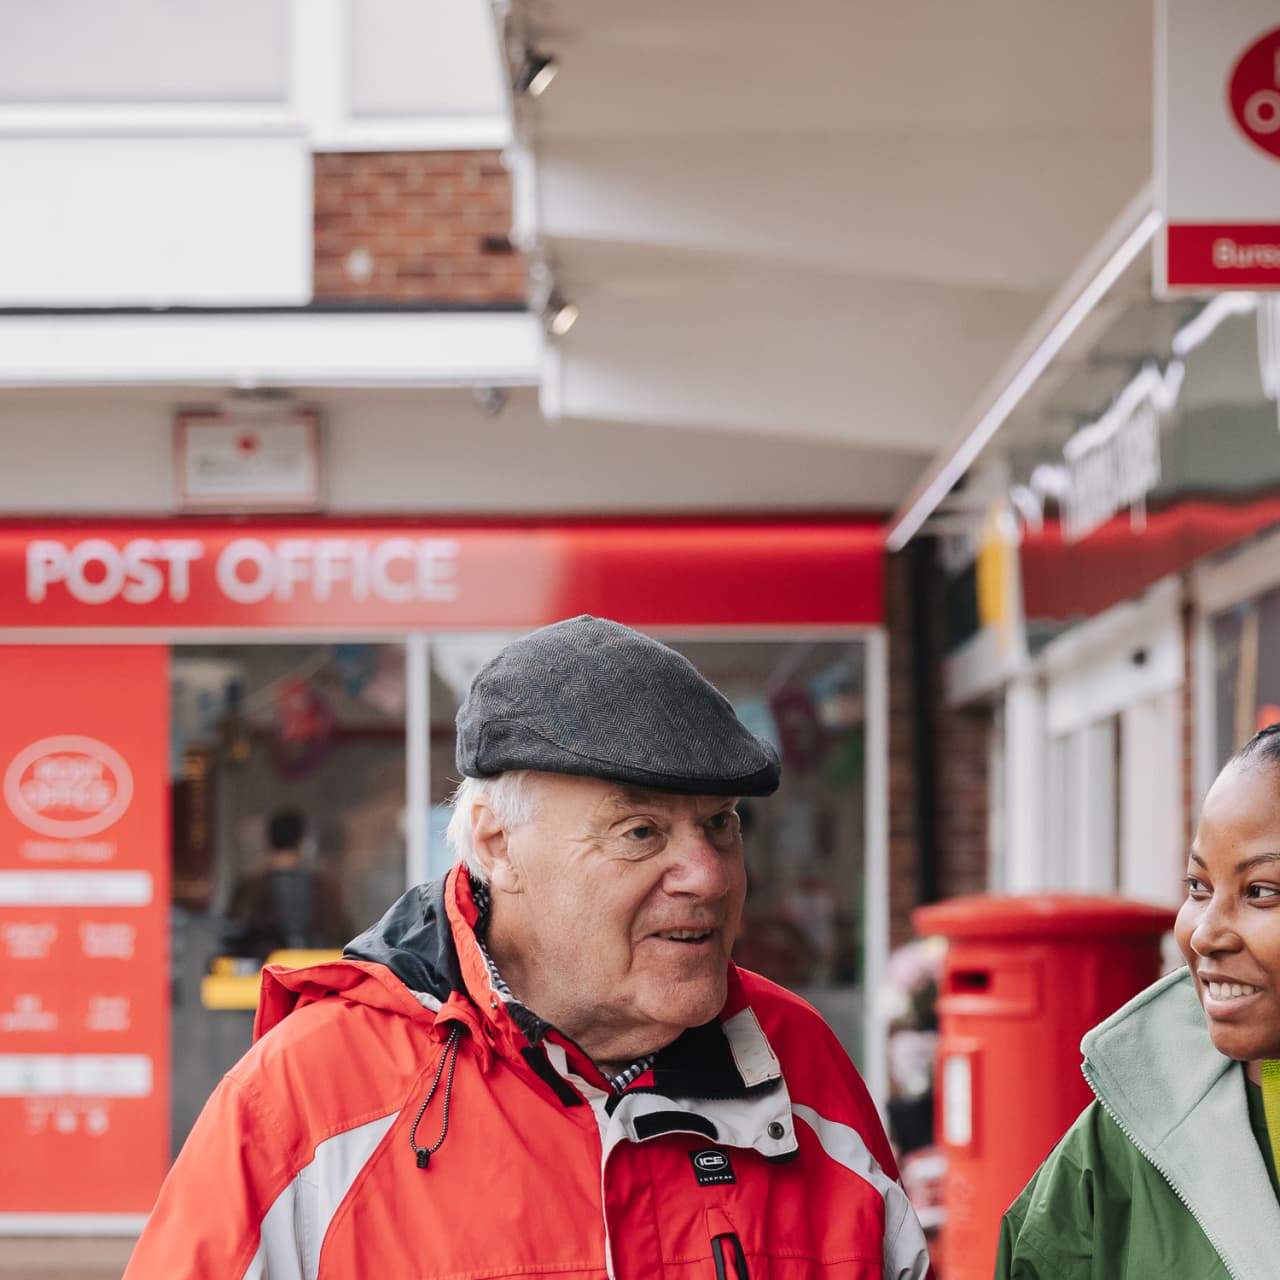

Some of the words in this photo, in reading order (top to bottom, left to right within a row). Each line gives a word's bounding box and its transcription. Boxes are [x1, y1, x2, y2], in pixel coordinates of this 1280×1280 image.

[25, 538, 204, 604] POST
[216, 537, 461, 603] OFFICE
[699, 1156, 724, 1166] ICE
